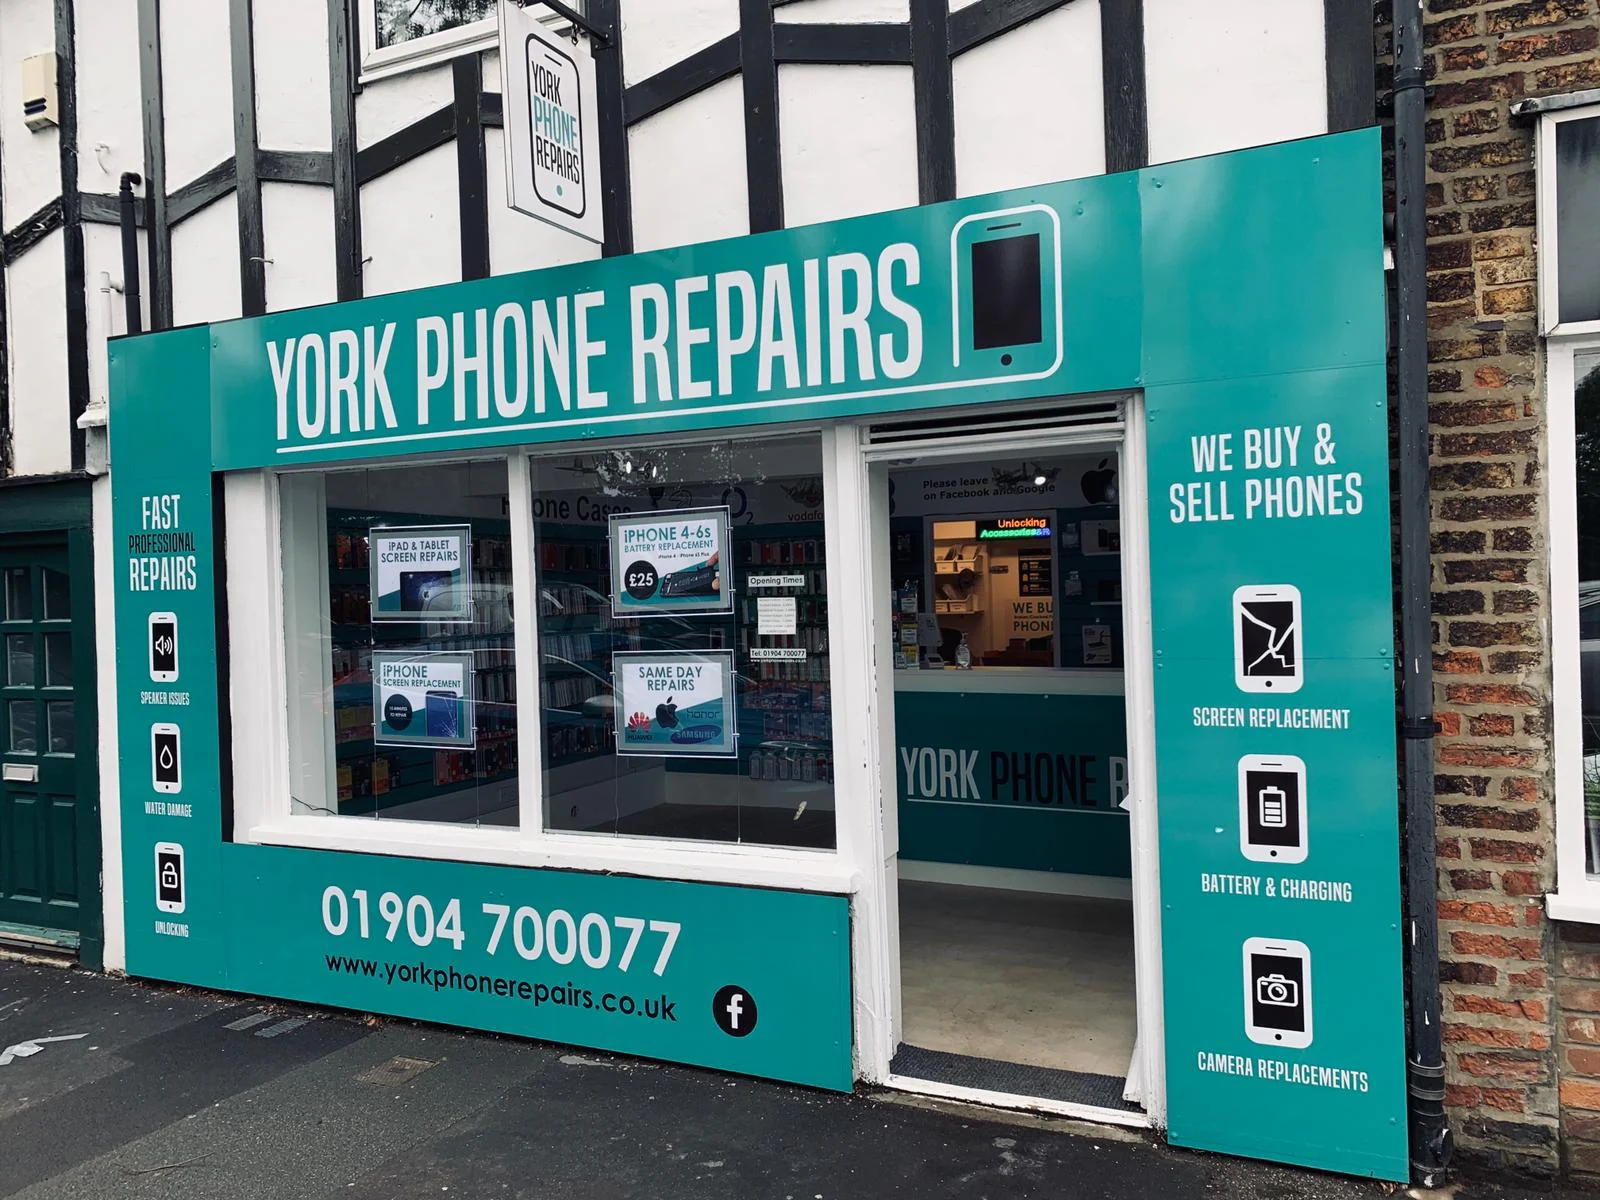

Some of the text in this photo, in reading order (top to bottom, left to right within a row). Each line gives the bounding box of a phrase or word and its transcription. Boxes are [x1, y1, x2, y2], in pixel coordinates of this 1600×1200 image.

[531, 60, 562, 107] YORK
[533, 95, 578, 152] PHONE
[536, 135, 580, 185] REPAIRS
[266, 243, 924, 440] YORK PHONE REPAIRS
[1191, 422, 1337, 473] WE BUY &
[923, 477, 957, 489] Please
[960, 475, 989, 487] leave
[923, 490, 937, 501] on
[939, 487, 990, 499] Facebook
[1016, 481, 1055, 494] Google
[1169, 472, 1363, 524] SELL PHONES
[142, 494, 180, 530] FAST
[998, 518, 1046, 529] Unlocking
[129, 532, 195, 553] PROFESSIONAL
[624, 525, 711, 543] iPHONE 4-6s
[388, 540, 449, 551] iPAD & TABLET
[625, 540, 714, 552] BATTERY REPLACEMENT
[381, 551, 458, 562] SCREEN REPAIRS
[129, 556, 197, 591] REPAIRS
[628, 573, 653, 587] £25
[750, 577, 781, 585] Opening
[1013, 602, 1053, 613] WE BU
[1013, 621, 1053, 631] PHON
[383, 665, 427, 678] iPHONE
[639, 667, 702, 678] SAME DAY
[383, 679, 461, 688] SCREEN REPLACEMENT
[647, 680, 695, 691] REPAIRS
[140, 691, 190, 706] SPEAKER ISSUES
[687, 709, 720, 719] honor
[1193, 707, 1350, 729] SCREEN REPLACEMENT
[901, 747, 981, 799] YORK
[990, 750, 1097, 807] PHONE
[144, 801, 192, 817] WATER DAMAGE
[1201, 873, 1352, 902] BATTERY & CHARGING
[155, 921, 189, 937] UNLOCKING
[322, 885, 682, 977] 01904 700077
[325, 954, 678, 1021] www.yorkphonerepairs.co.uk
[1197, 1051, 1369, 1093] CAMERA REPLACEMENTS
